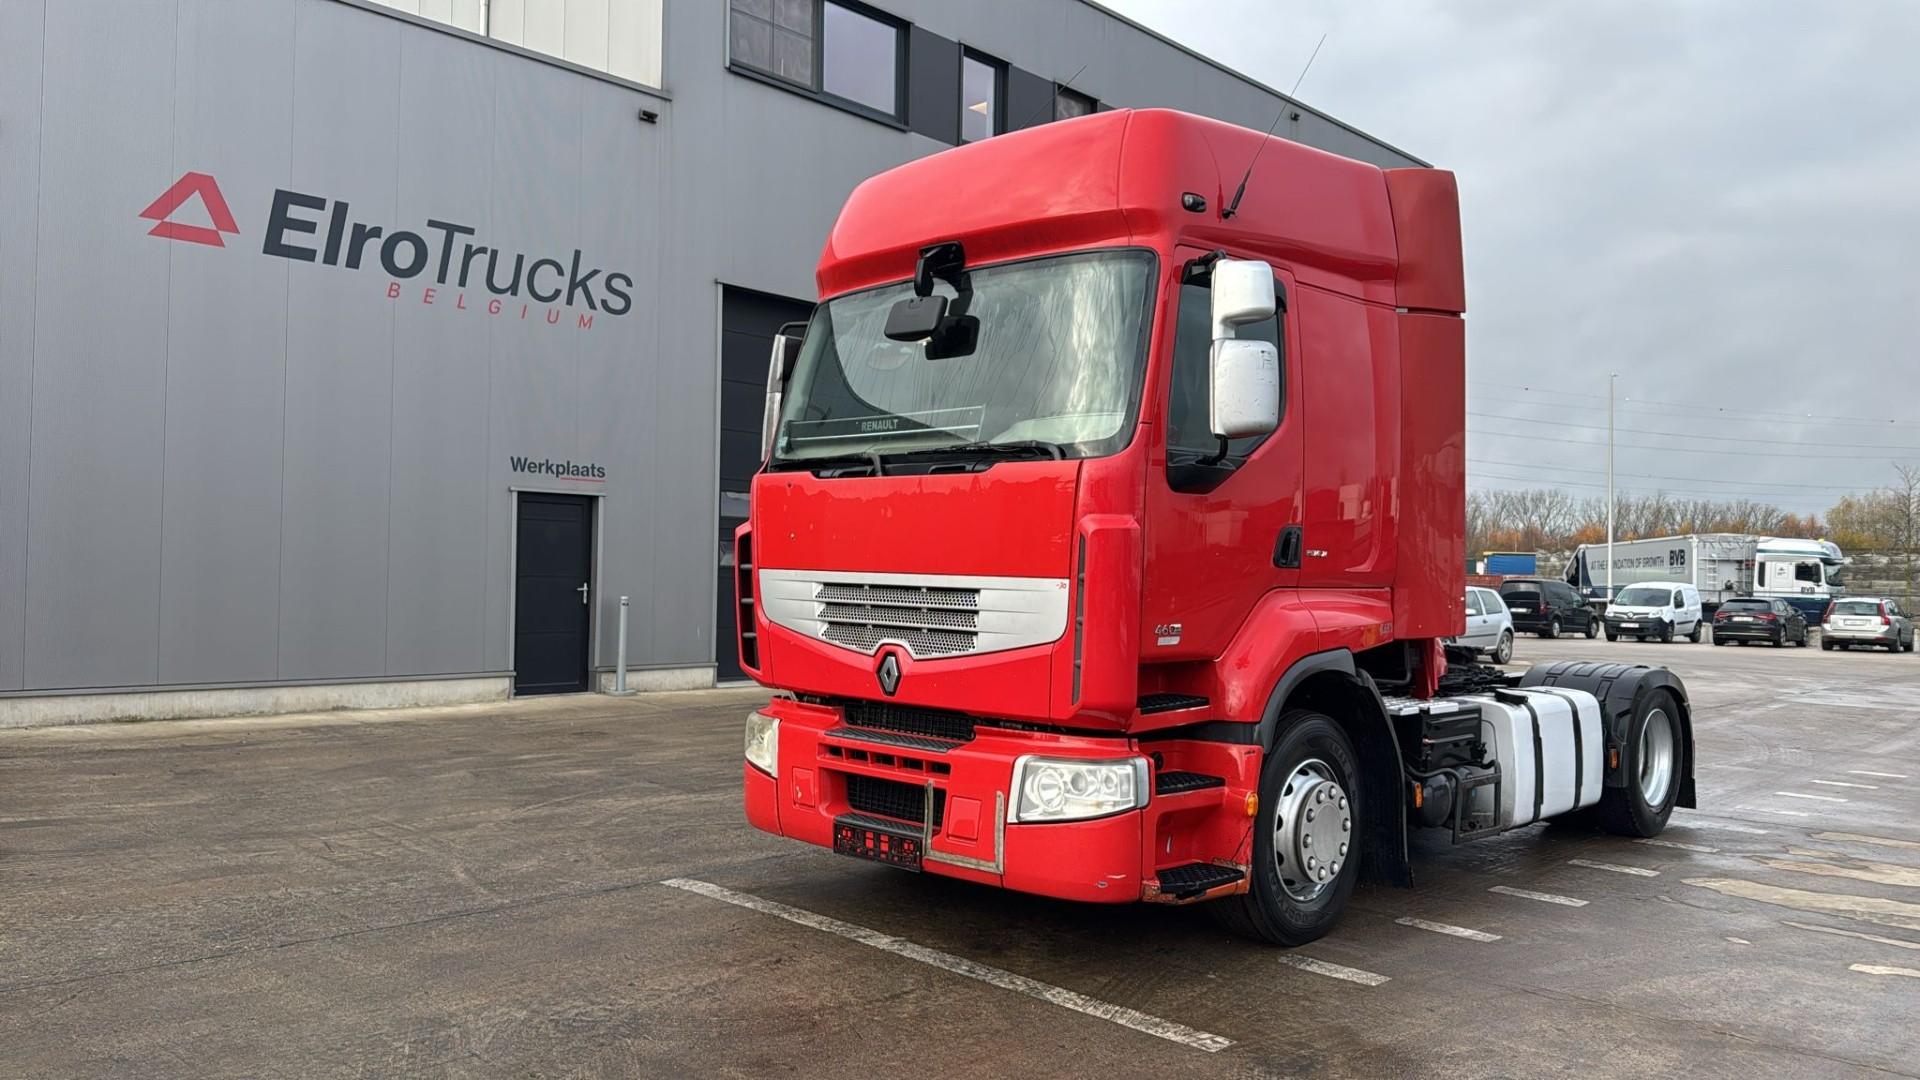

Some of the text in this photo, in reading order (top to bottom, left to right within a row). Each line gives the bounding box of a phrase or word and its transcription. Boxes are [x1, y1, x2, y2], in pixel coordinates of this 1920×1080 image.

[262, 188, 634, 316] ElroTrucks
[386, 281, 594, 331] BELGIUM
[861, 419, 899, 432] RENAULT
[510, 456, 606, 478] Werkplaats
[1669, 549, 1686, 566] BVB
